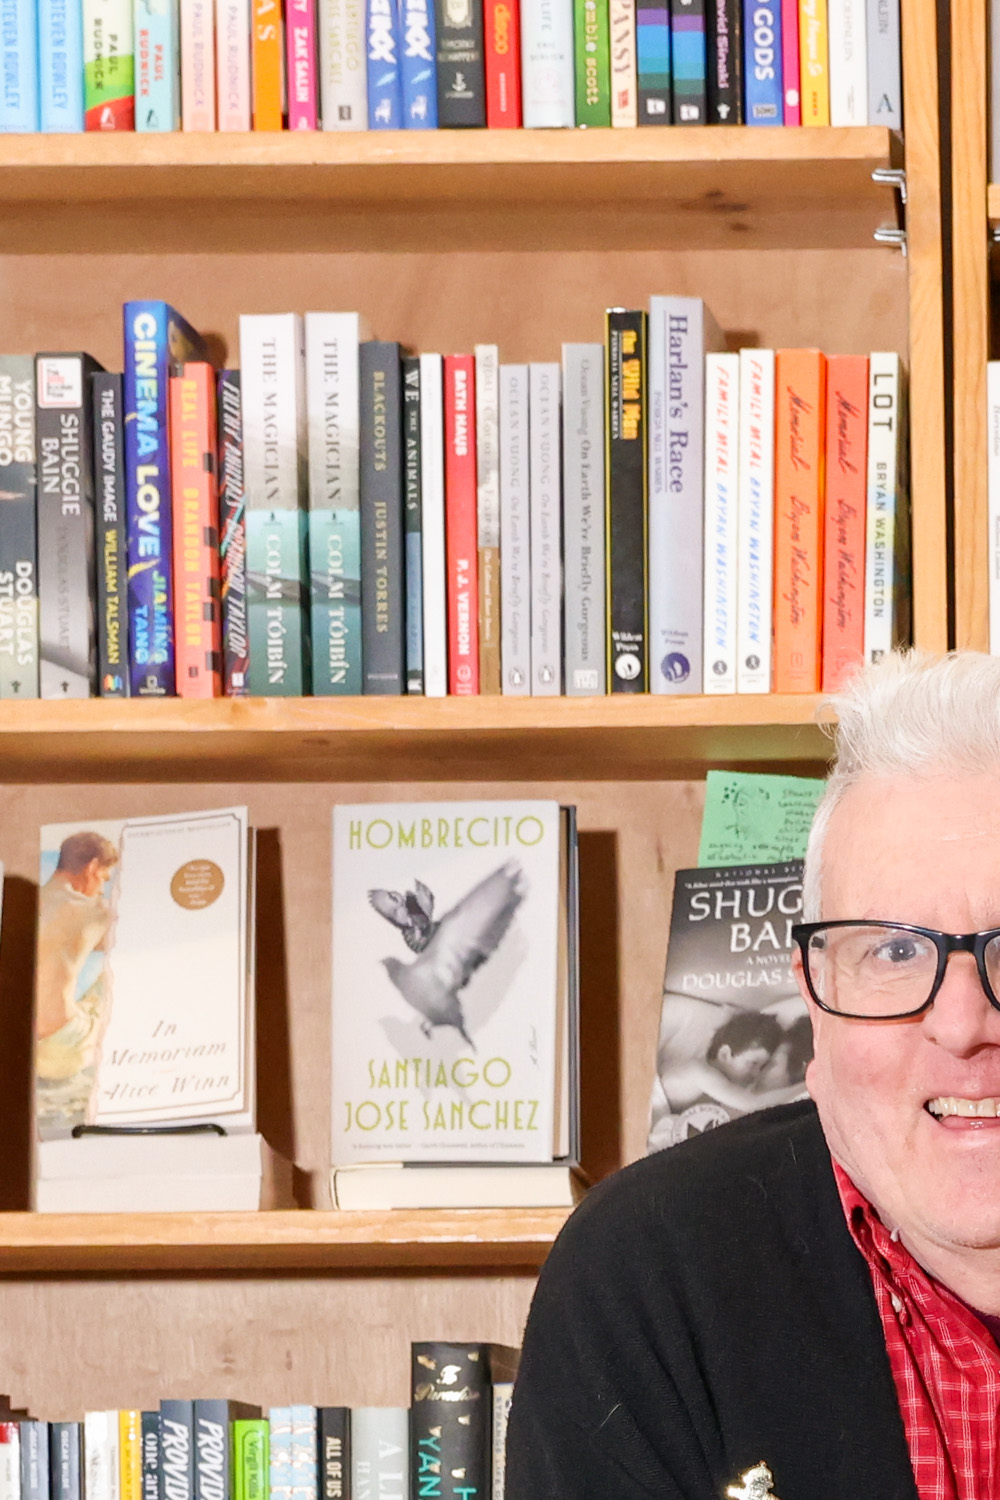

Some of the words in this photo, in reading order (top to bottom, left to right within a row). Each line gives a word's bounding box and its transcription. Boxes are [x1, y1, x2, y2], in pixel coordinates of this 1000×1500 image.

[94, 18, 103, 90] RUDNICK
[108, 34, 118, 75] PAUL
[133, 313, 158, 456] CINEMA
[323, 338, 337, 383] THE
[669, 315, 690, 419] Harlan's
[102, 390, 114, 417] THE
[181, 381, 197, 421] REAL
[454, 370, 467, 410] BATH
[873, 373, 893, 431] LOT
[374, 371, 386, 470] BLACKOUTS
[454, 414, 468, 455] HAUS
[41, 438, 58, 492] BAIN
[60, 414, 79, 516] SHUGGIE
[103, 421, 115, 471] GAUDY
[182, 431, 197, 467] LIFE
[325, 392, 341, 500] MAGICIAN
[670, 430, 689, 493] Race
[104, 476, 116, 521] IMAGE
[137, 466, 160, 556] LOVE
[876, 462, 887, 511] BRYAN
[183, 489, 198, 571] BRANDON
[375, 502, 387, 559] JUSTIN
[105, 530, 117, 591] WILLIAM
[328, 534, 344, 598] COLM
[873, 519, 886, 617] WASHINGTON
[153, 572, 167, 664] JIAMING
[186, 583, 200, 646] TAYLOR
[376, 566, 388, 632] TORRES
[457, 592, 470, 655] VERNON
[106, 596, 119, 663] TALSMAN
[135, 606, 149, 664] TANG
[350, 815, 545, 850] HOMBRECITO
[688, 885, 803, 921] SHUG
[729, 923, 793, 953] BAI
[682, 969, 781, 991] DOUGLAS
[109, 1040, 227, 1066] Memoriam
[152, 1020, 177, 1038] In
[104, 1081, 158, 1100] Alice
[172, 1074, 230, 1096] Winn
[369, 1058, 511, 1088] SANTIAGO
[344, 1101, 409, 1132] JOSE
[423, 1100, 539, 1131] SANCHEZ
[326, 1437, 341, 1459] ALL
[327, 1462, 341, 1478] OF
[327, 1480, 341, 1496] US
